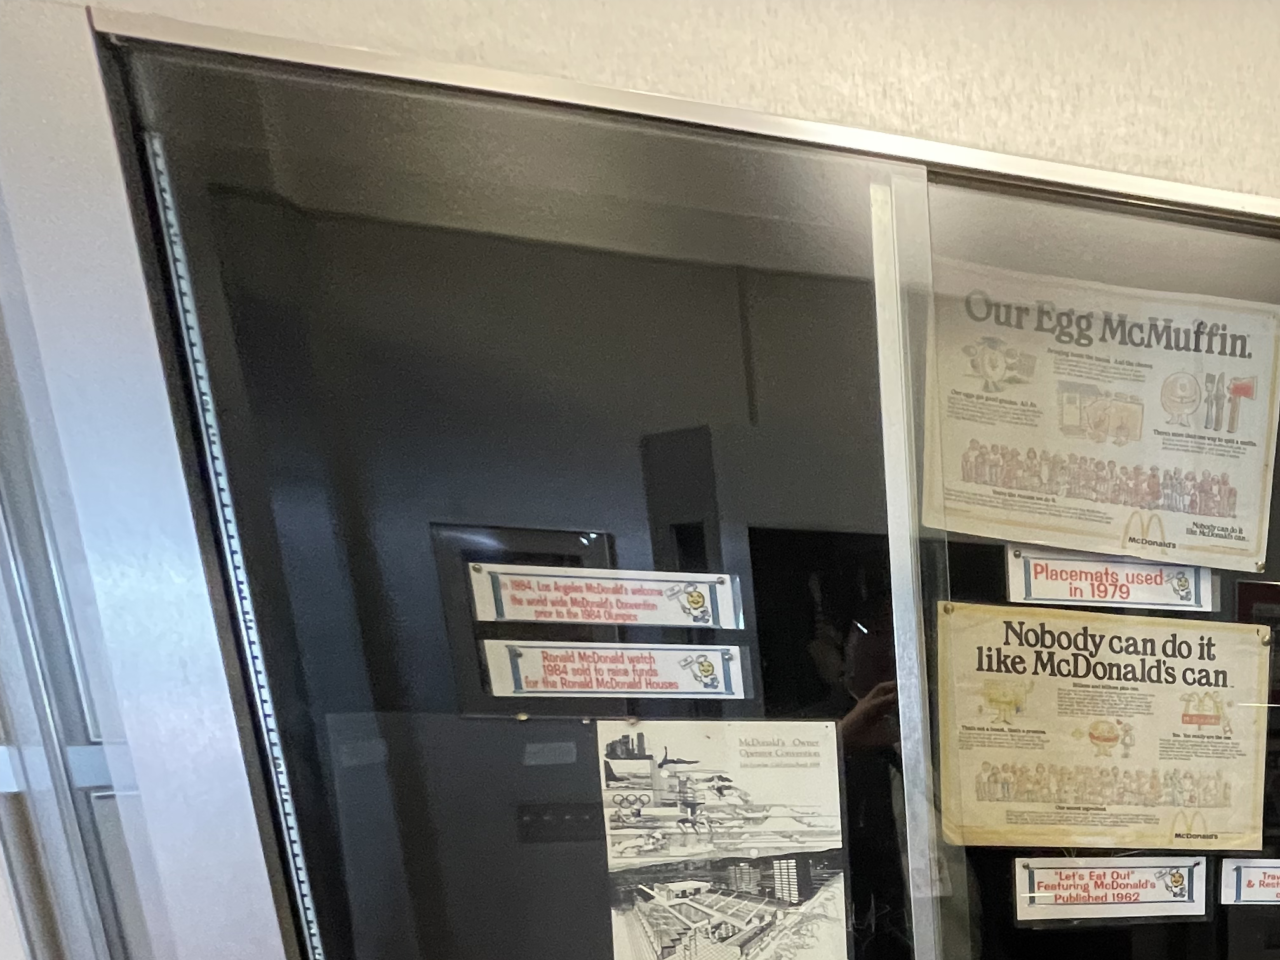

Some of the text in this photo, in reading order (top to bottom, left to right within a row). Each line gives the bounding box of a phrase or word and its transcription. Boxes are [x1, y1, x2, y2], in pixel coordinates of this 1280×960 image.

[964, 288, 1030, 330] Our
[1034, 300, 1094, 348] Egg
[1128, 536, 1177, 549] McDonald's
[1033, 563, 1164, 586] Placemats used
[537, 580, 552, 592] Los
[553, 581, 583, 597] Angeles
[585, 582, 628, 596] McDonald's
[1069, 582, 1130, 600] in 1979
[510, 595, 658, 611] the world wide McDonald's Convention
[534, 608, 552, 620] prior
[556, 608, 564, 619] to
[566, 609, 579, 620] the
[581, 609, 601, 621] 1984
[1003, 620, 1216, 661] Nobody can do it
[541, 650, 656, 665] Ronald McDonald watch
[976, 646, 1027, 675] like
[1032, 650, 1176, 684] McDonald's
[542, 663, 659, 678] 1984 sold to raise funds
[525, 676, 679, 690] for the Ronald McDonald Houses
[1174, 832, 1219, 840] McDonald's
[1089, 871, 1106, 881] Eat
[1037, 879, 1156, 893] Featuring McDonald's
[1246, 880, 1255, 888] &
[1054, 892, 1140, 903] Published 1962
